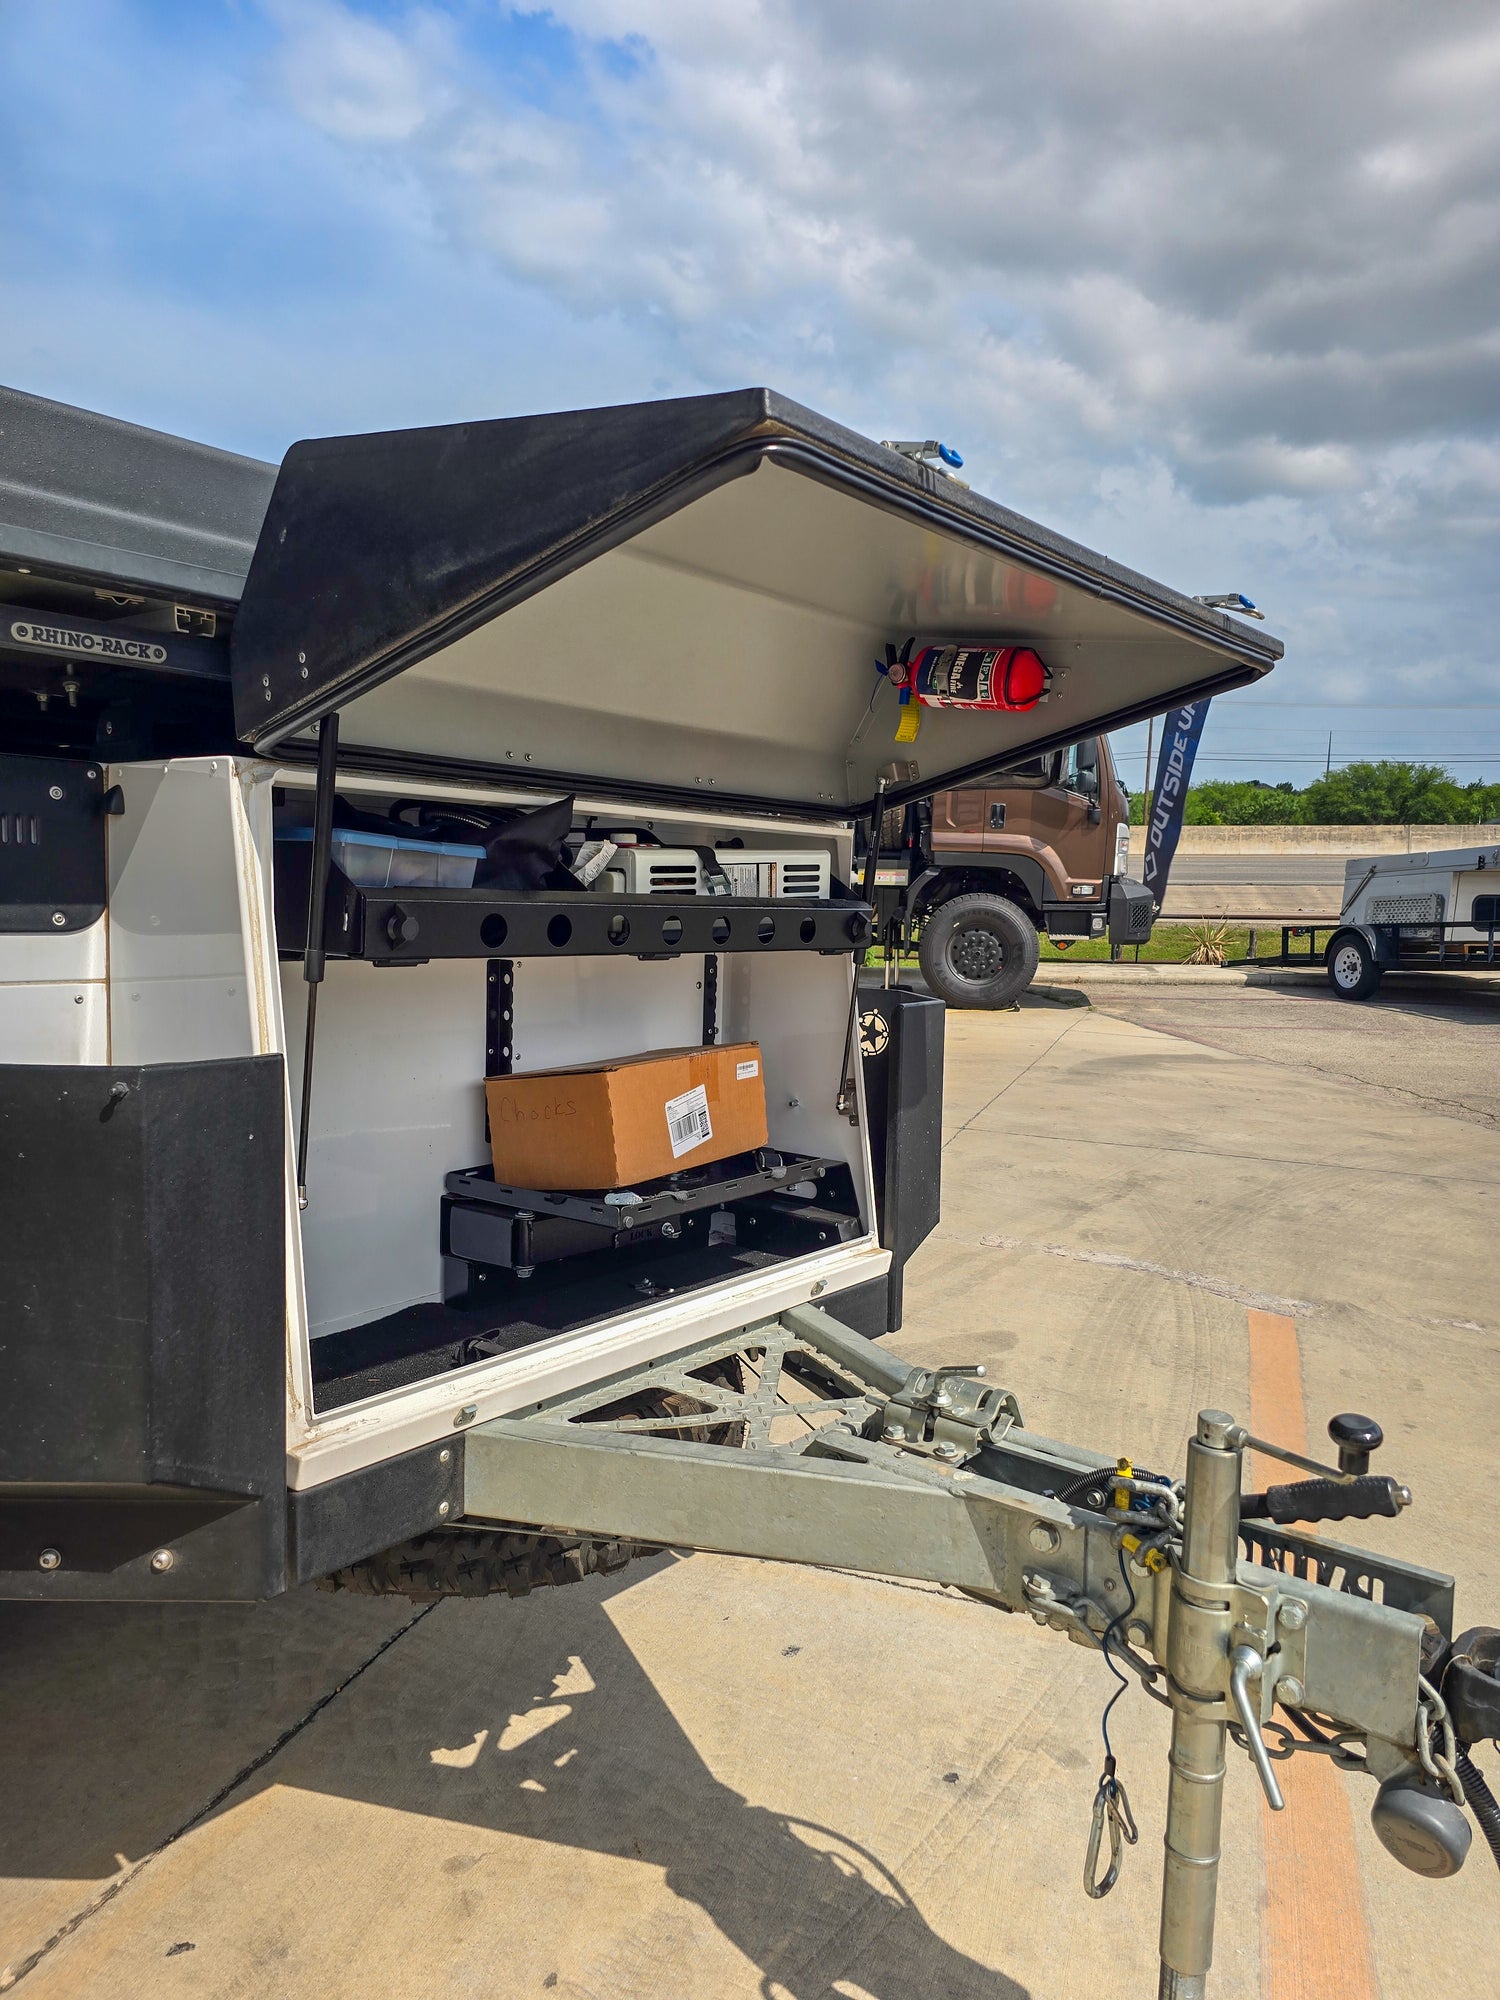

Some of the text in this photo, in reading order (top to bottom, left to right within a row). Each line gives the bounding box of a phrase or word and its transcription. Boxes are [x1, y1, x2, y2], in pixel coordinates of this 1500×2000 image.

[31, 626, 151, 659] RHINO-RACK
[951, 653, 969, 679] MEGA
[1150, 732, 1188, 849] OUTSIDE
[501, 1097, 577, 1121] Chocks
